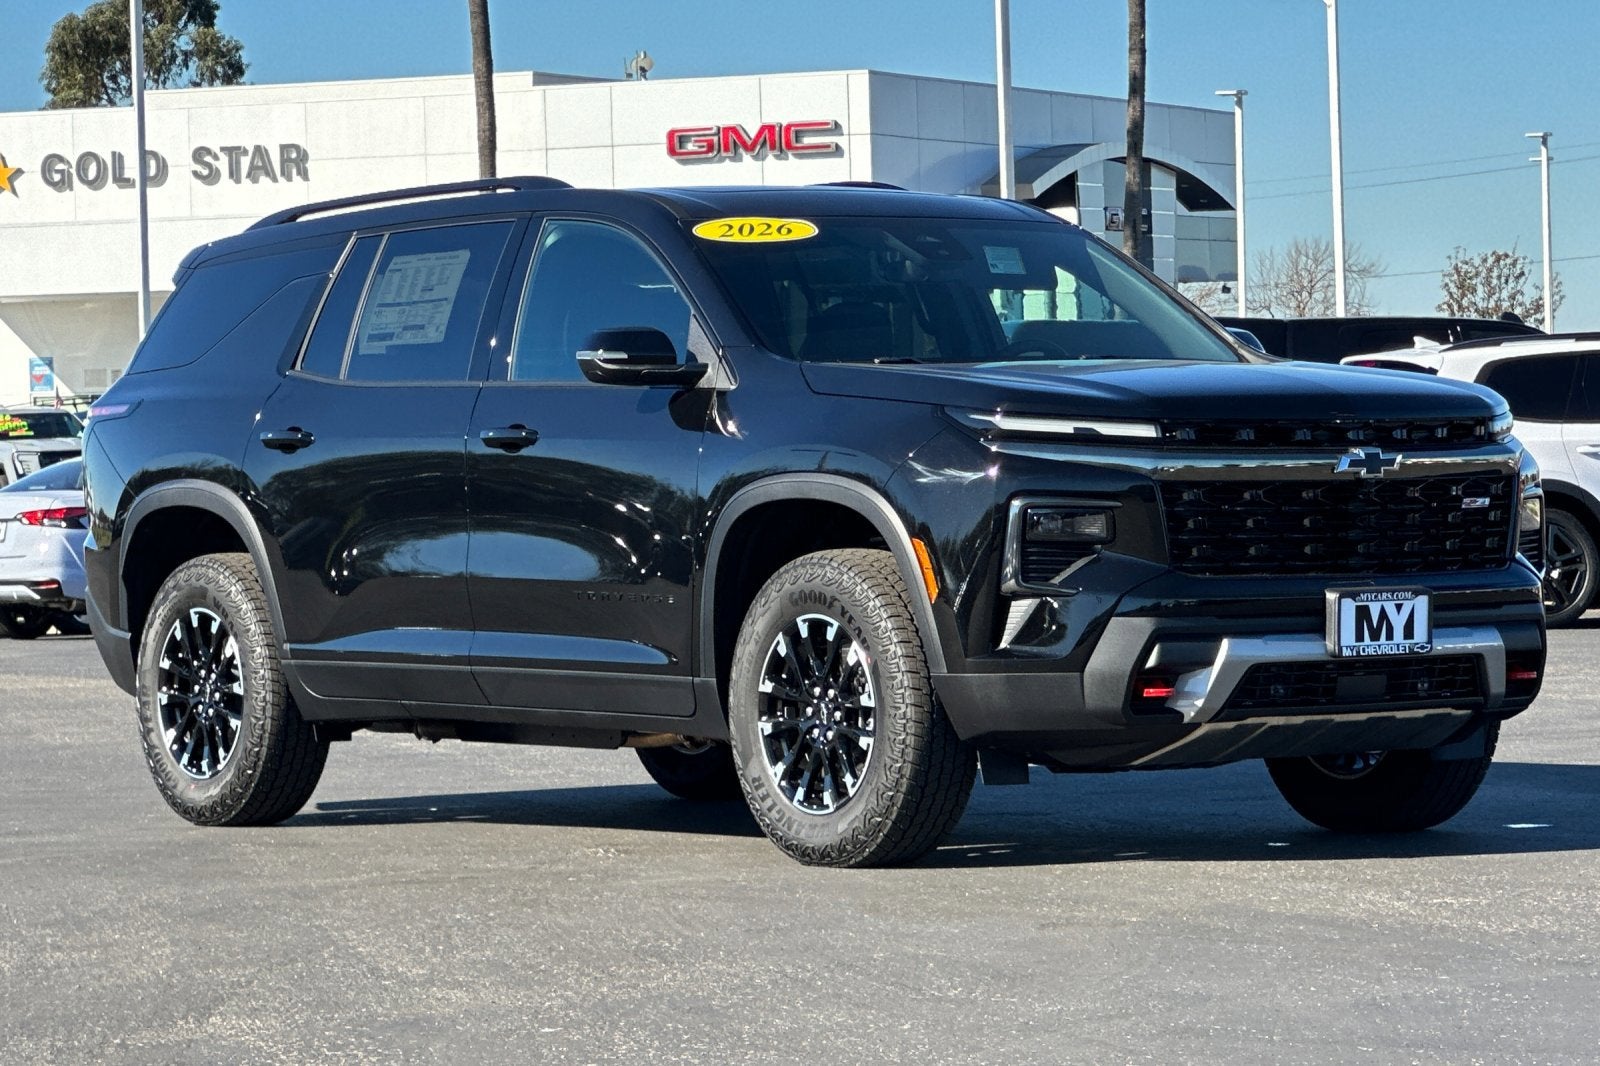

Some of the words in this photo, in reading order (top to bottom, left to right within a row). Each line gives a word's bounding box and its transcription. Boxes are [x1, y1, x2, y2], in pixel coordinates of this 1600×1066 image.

[666, 119, 836, 160] GMC
[41, 149, 168, 193] GOLD
[191, 143, 310, 186] STAR
[718, 222, 793, 238] 2026
[1359, 591, 1412, 602] MYCARS.COM
[789, 589, 871, 652] GOODYEAR
[1355, 601, 1415, 644] MY
[1342, 646, 1357, 657] MY
[1360, 643, 1410, 656] CHEVROLET
